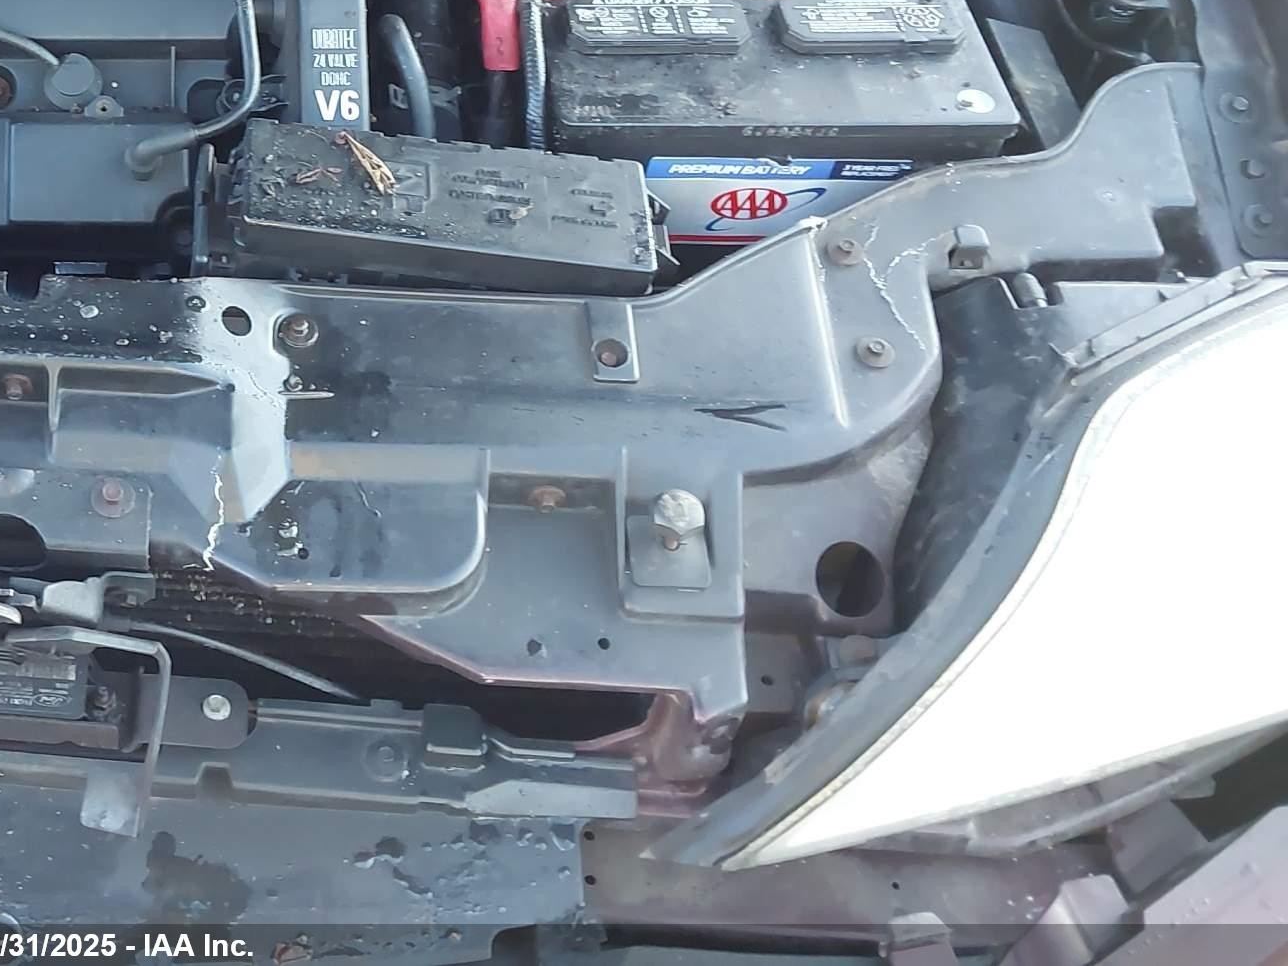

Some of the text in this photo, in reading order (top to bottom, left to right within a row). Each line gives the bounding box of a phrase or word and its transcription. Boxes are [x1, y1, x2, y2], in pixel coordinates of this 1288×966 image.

[311, 28, 358, 50] DURATEC
[327, 54, 359, 68] VALVE
[321, 71, 352, 86] DOHC
[314, 89, 360, 121] V6
[668, 163, 740, 175] PREMIUM
[714, 188, 785, 219] AAA
